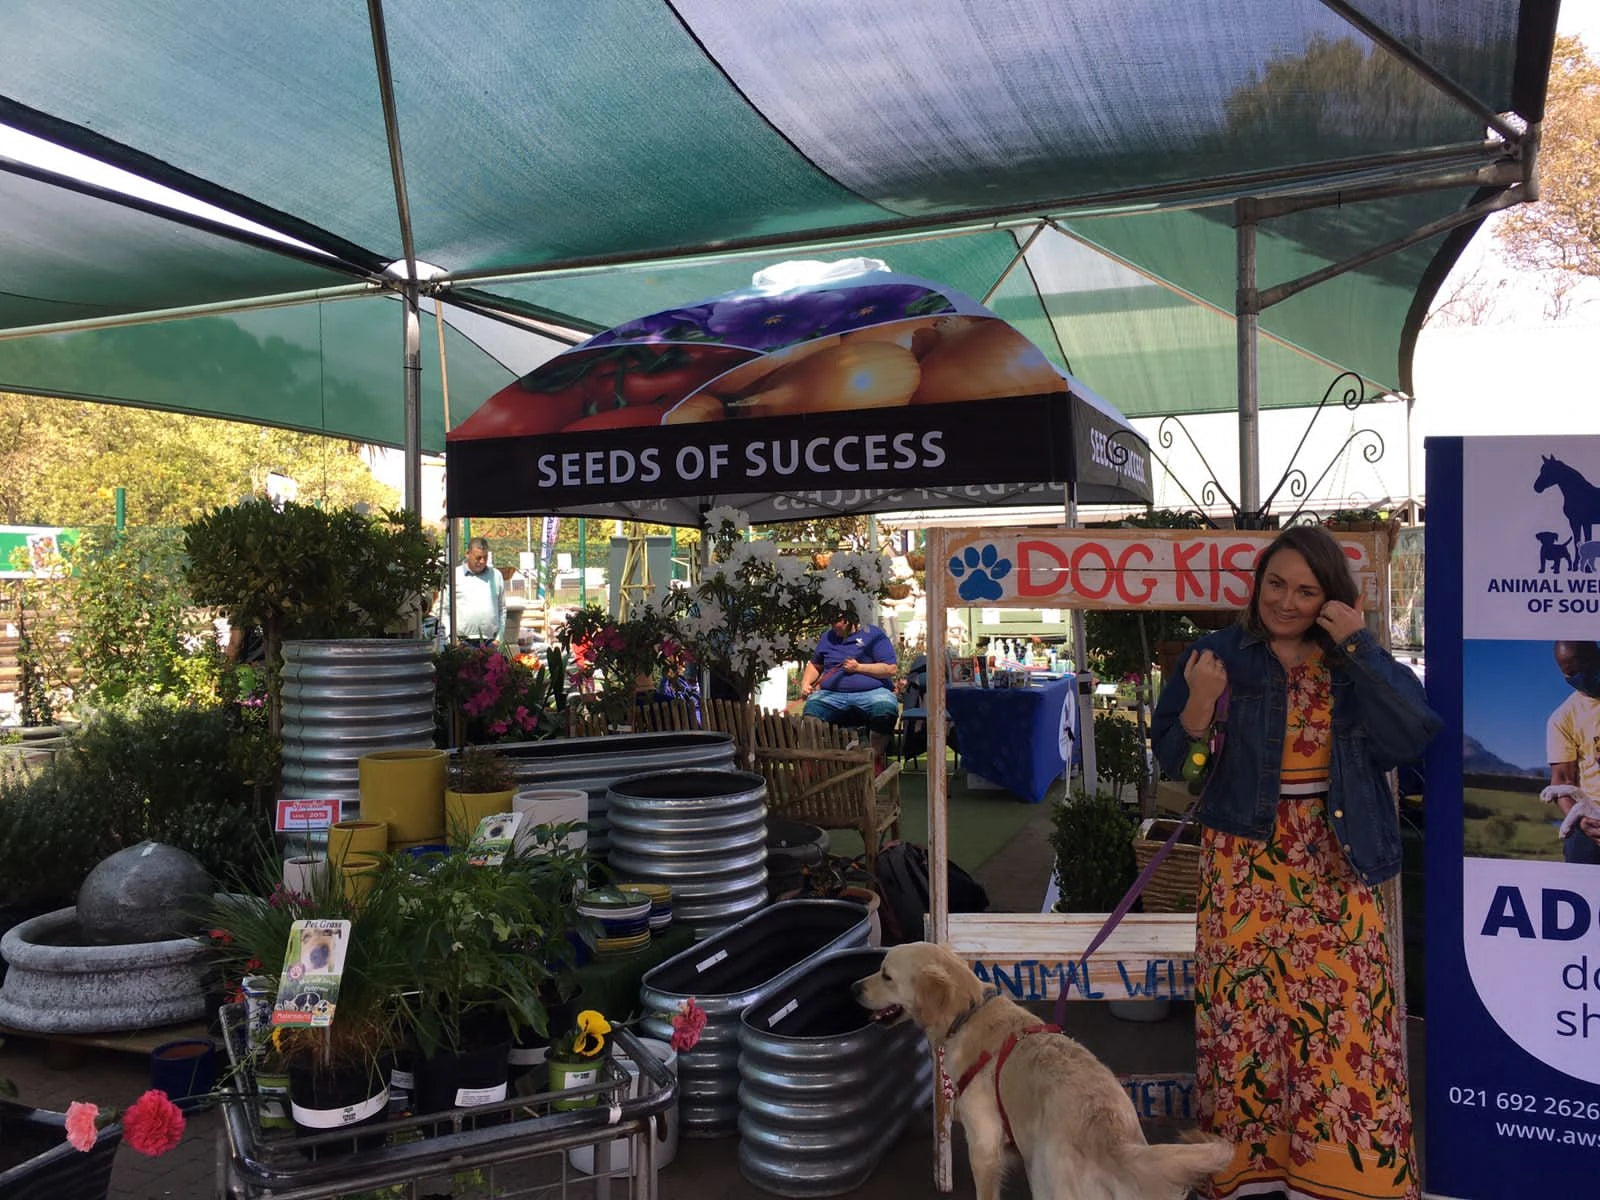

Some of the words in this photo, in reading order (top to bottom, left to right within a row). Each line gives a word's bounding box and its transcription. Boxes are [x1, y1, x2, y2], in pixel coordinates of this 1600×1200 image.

[537, 447, 662, 488] SEEDS
[675, 444, 729, 480] OF
[745, 430, 947, 478] SUCCESS
[1016, 540, 1158, 605] DOG
[1487, 578, 1564, 593] ANIMAL
[1567, 578, 1600, 593] WE
[1527, 598, 1553, 613] OF
[1558, 598, 1599, 614] SOU
[1480, 885, 1600, 942] AD
[974, 959, 1105, 1001] ANIMAL
[1449, 1086, 1487, 1107] 021
[1496, 1092, 1537, 1113] 692
[1543, 1097, 1600, 1120] 2626
